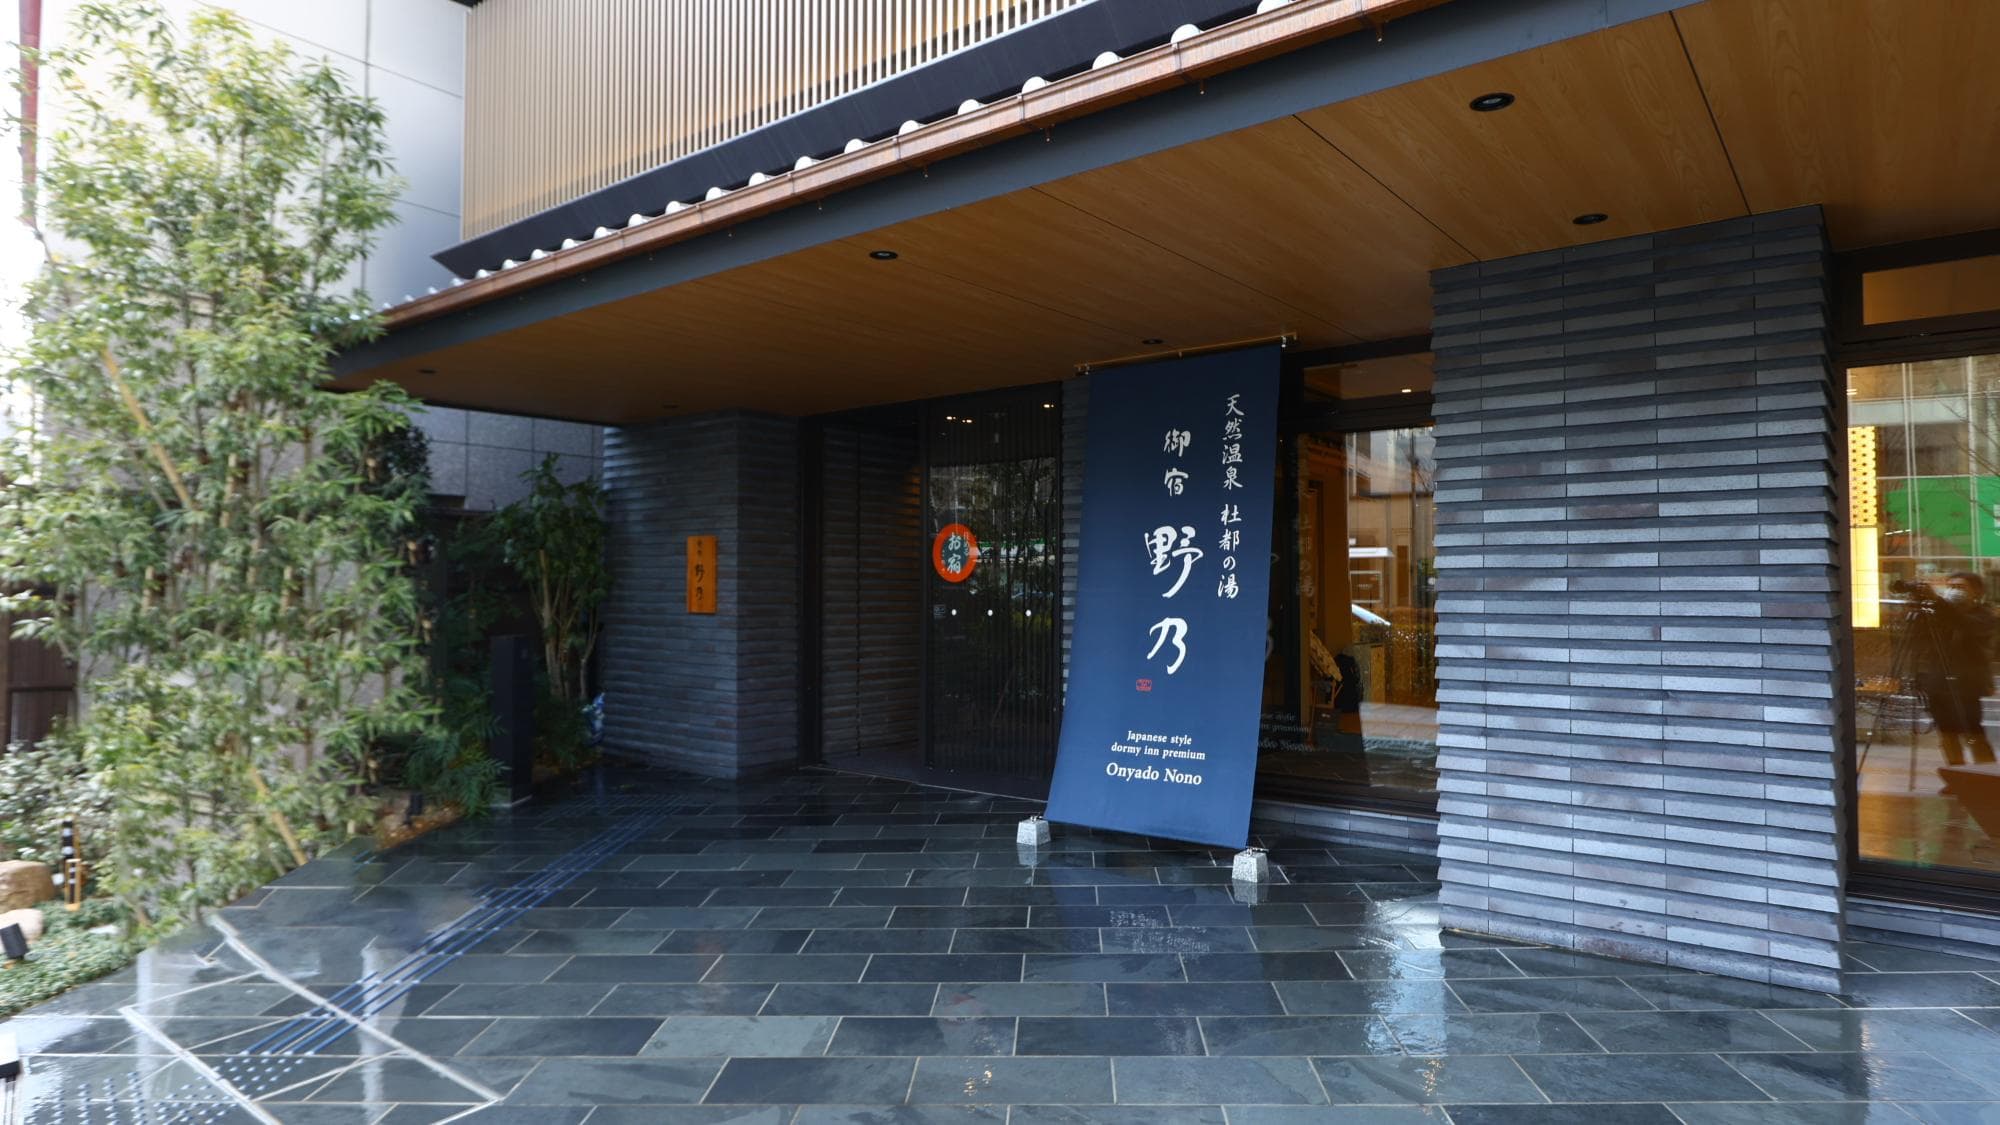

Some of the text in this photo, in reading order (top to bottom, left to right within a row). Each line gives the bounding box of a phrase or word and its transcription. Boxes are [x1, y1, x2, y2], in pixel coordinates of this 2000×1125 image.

[1217, 393, 1245, 600] 天然温泉 杜都の湯
[946, 531, 962, 574] お宿
[1144, 428, 1204, 675] 御宿 野乃
[1111, 742, 1206, 760] dormy inn premium
[1127, 730, 1192, 747] Japanese style
[1106, 762, 1202, 786] Onyado Nono
